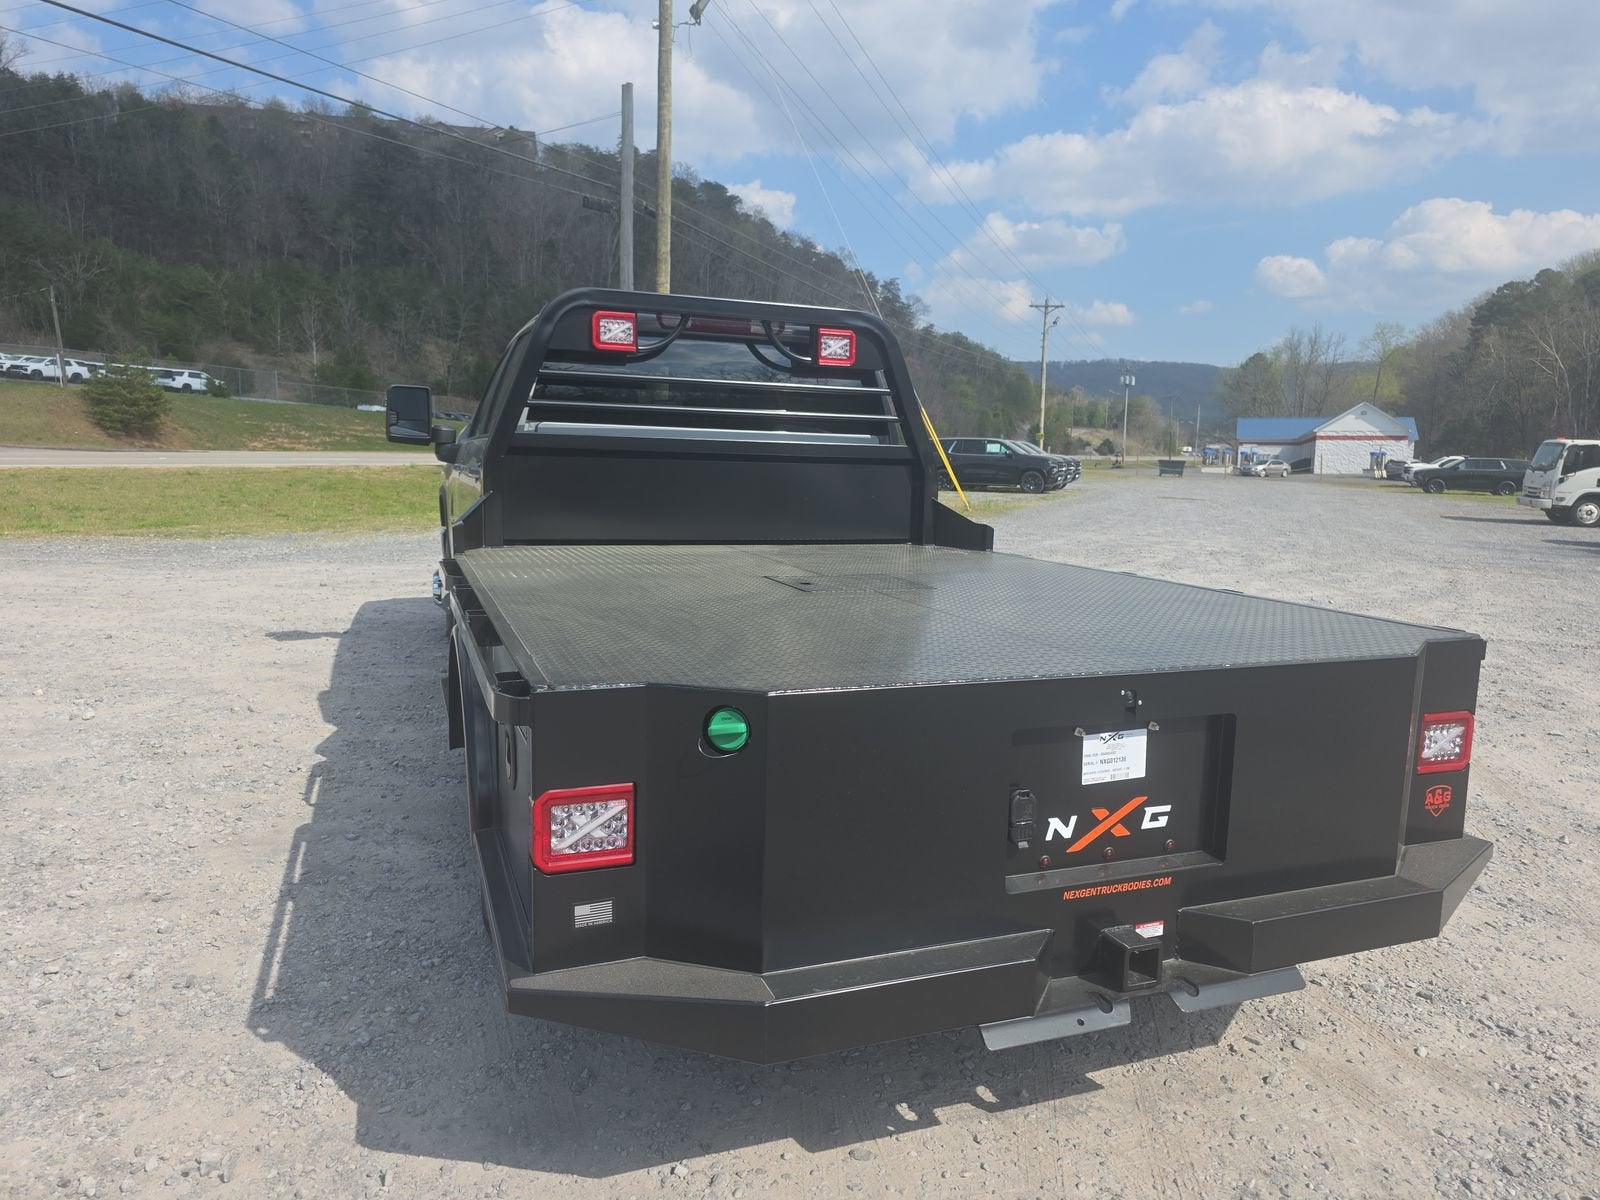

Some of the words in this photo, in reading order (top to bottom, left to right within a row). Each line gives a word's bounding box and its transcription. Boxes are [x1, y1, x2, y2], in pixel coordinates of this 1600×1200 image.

[1100, 731, 1124, 744] NXG
[1424, 789, 1451, 804] A&G
[1045, 796, 1172, 853] NXG
[1063, 877, 1173, 900] NEXGENTRUCKBODIES.COM
